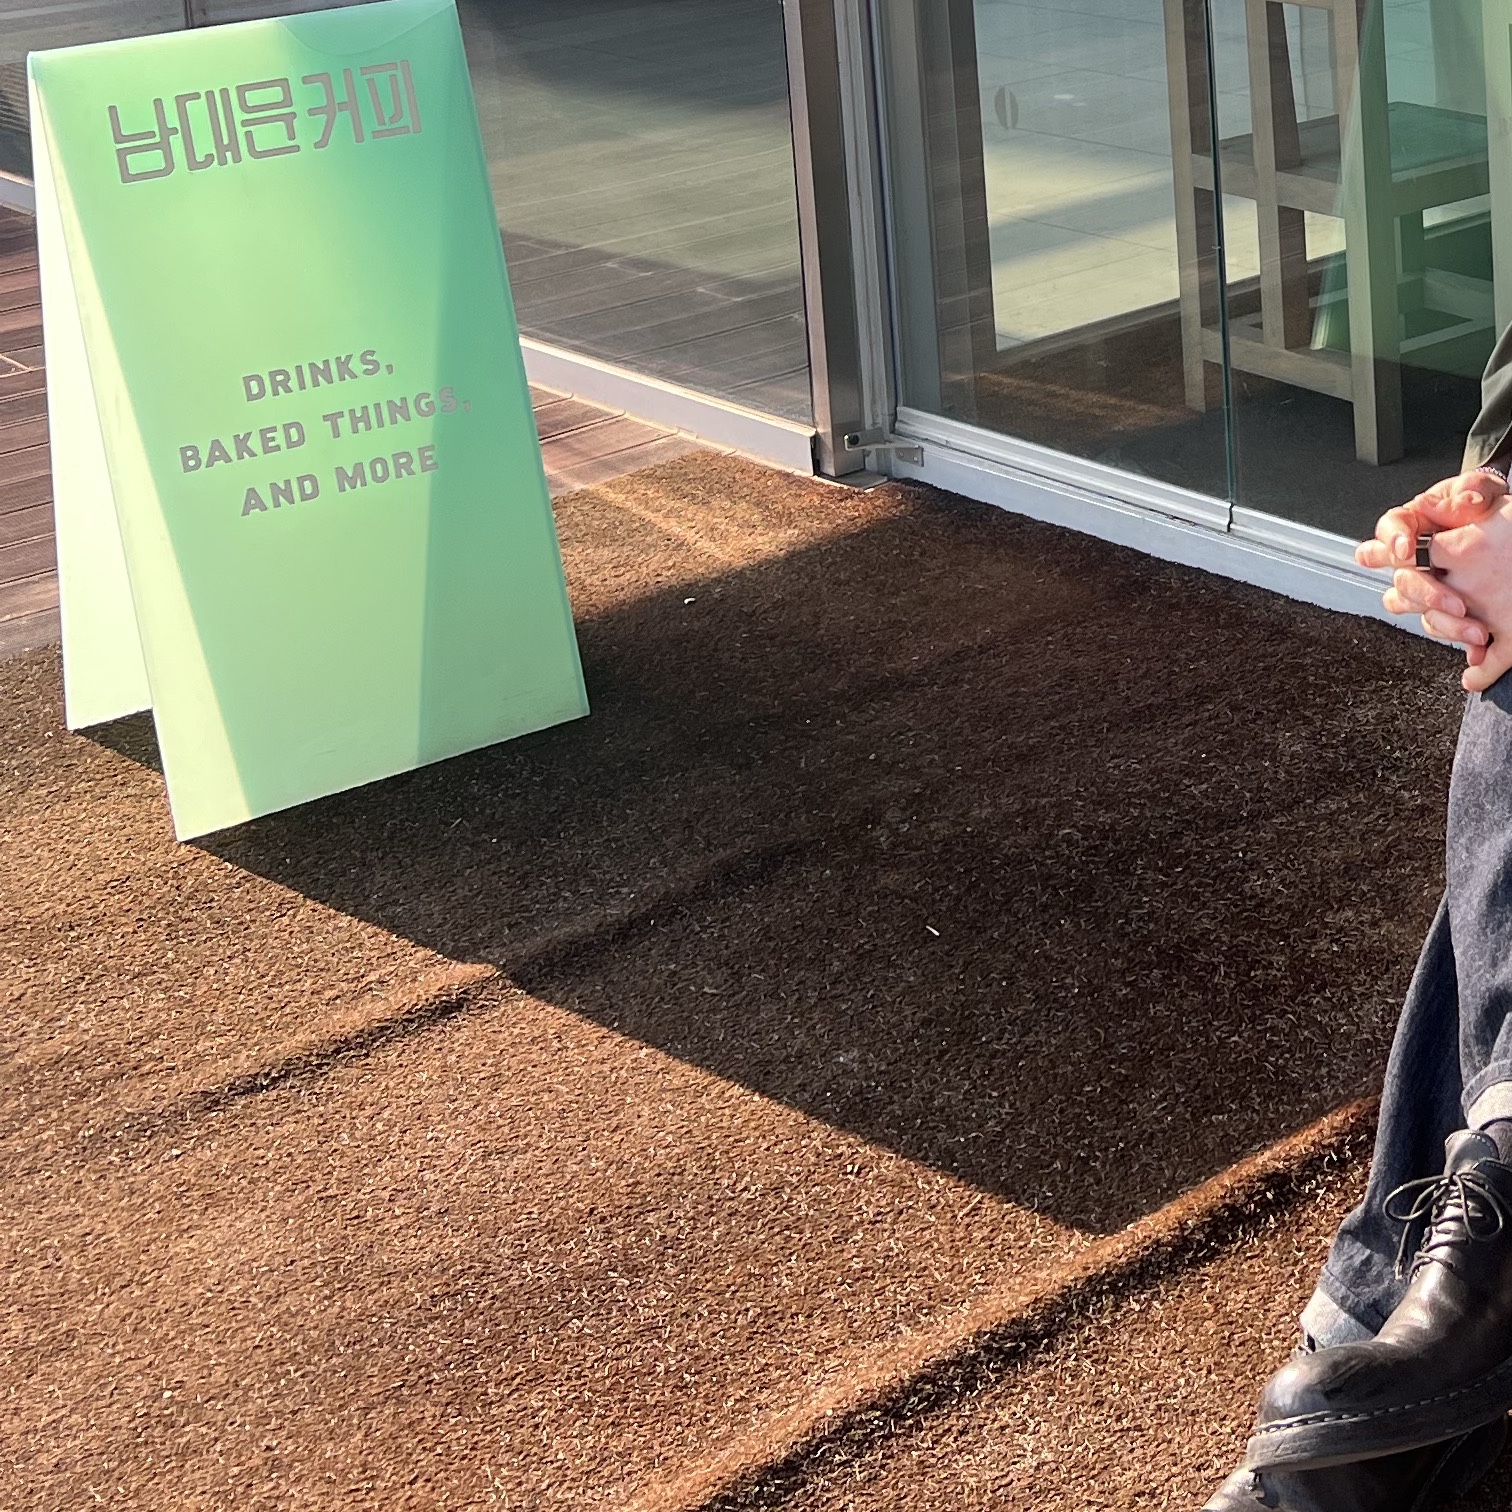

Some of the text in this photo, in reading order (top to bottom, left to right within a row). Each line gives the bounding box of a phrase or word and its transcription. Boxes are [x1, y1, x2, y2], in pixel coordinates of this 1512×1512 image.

[242, 348, 396, 402] DRINKS,
[179, 386, 474, 473] BAKED THINGS,
[240, 444, 439, 517] AND MORE
